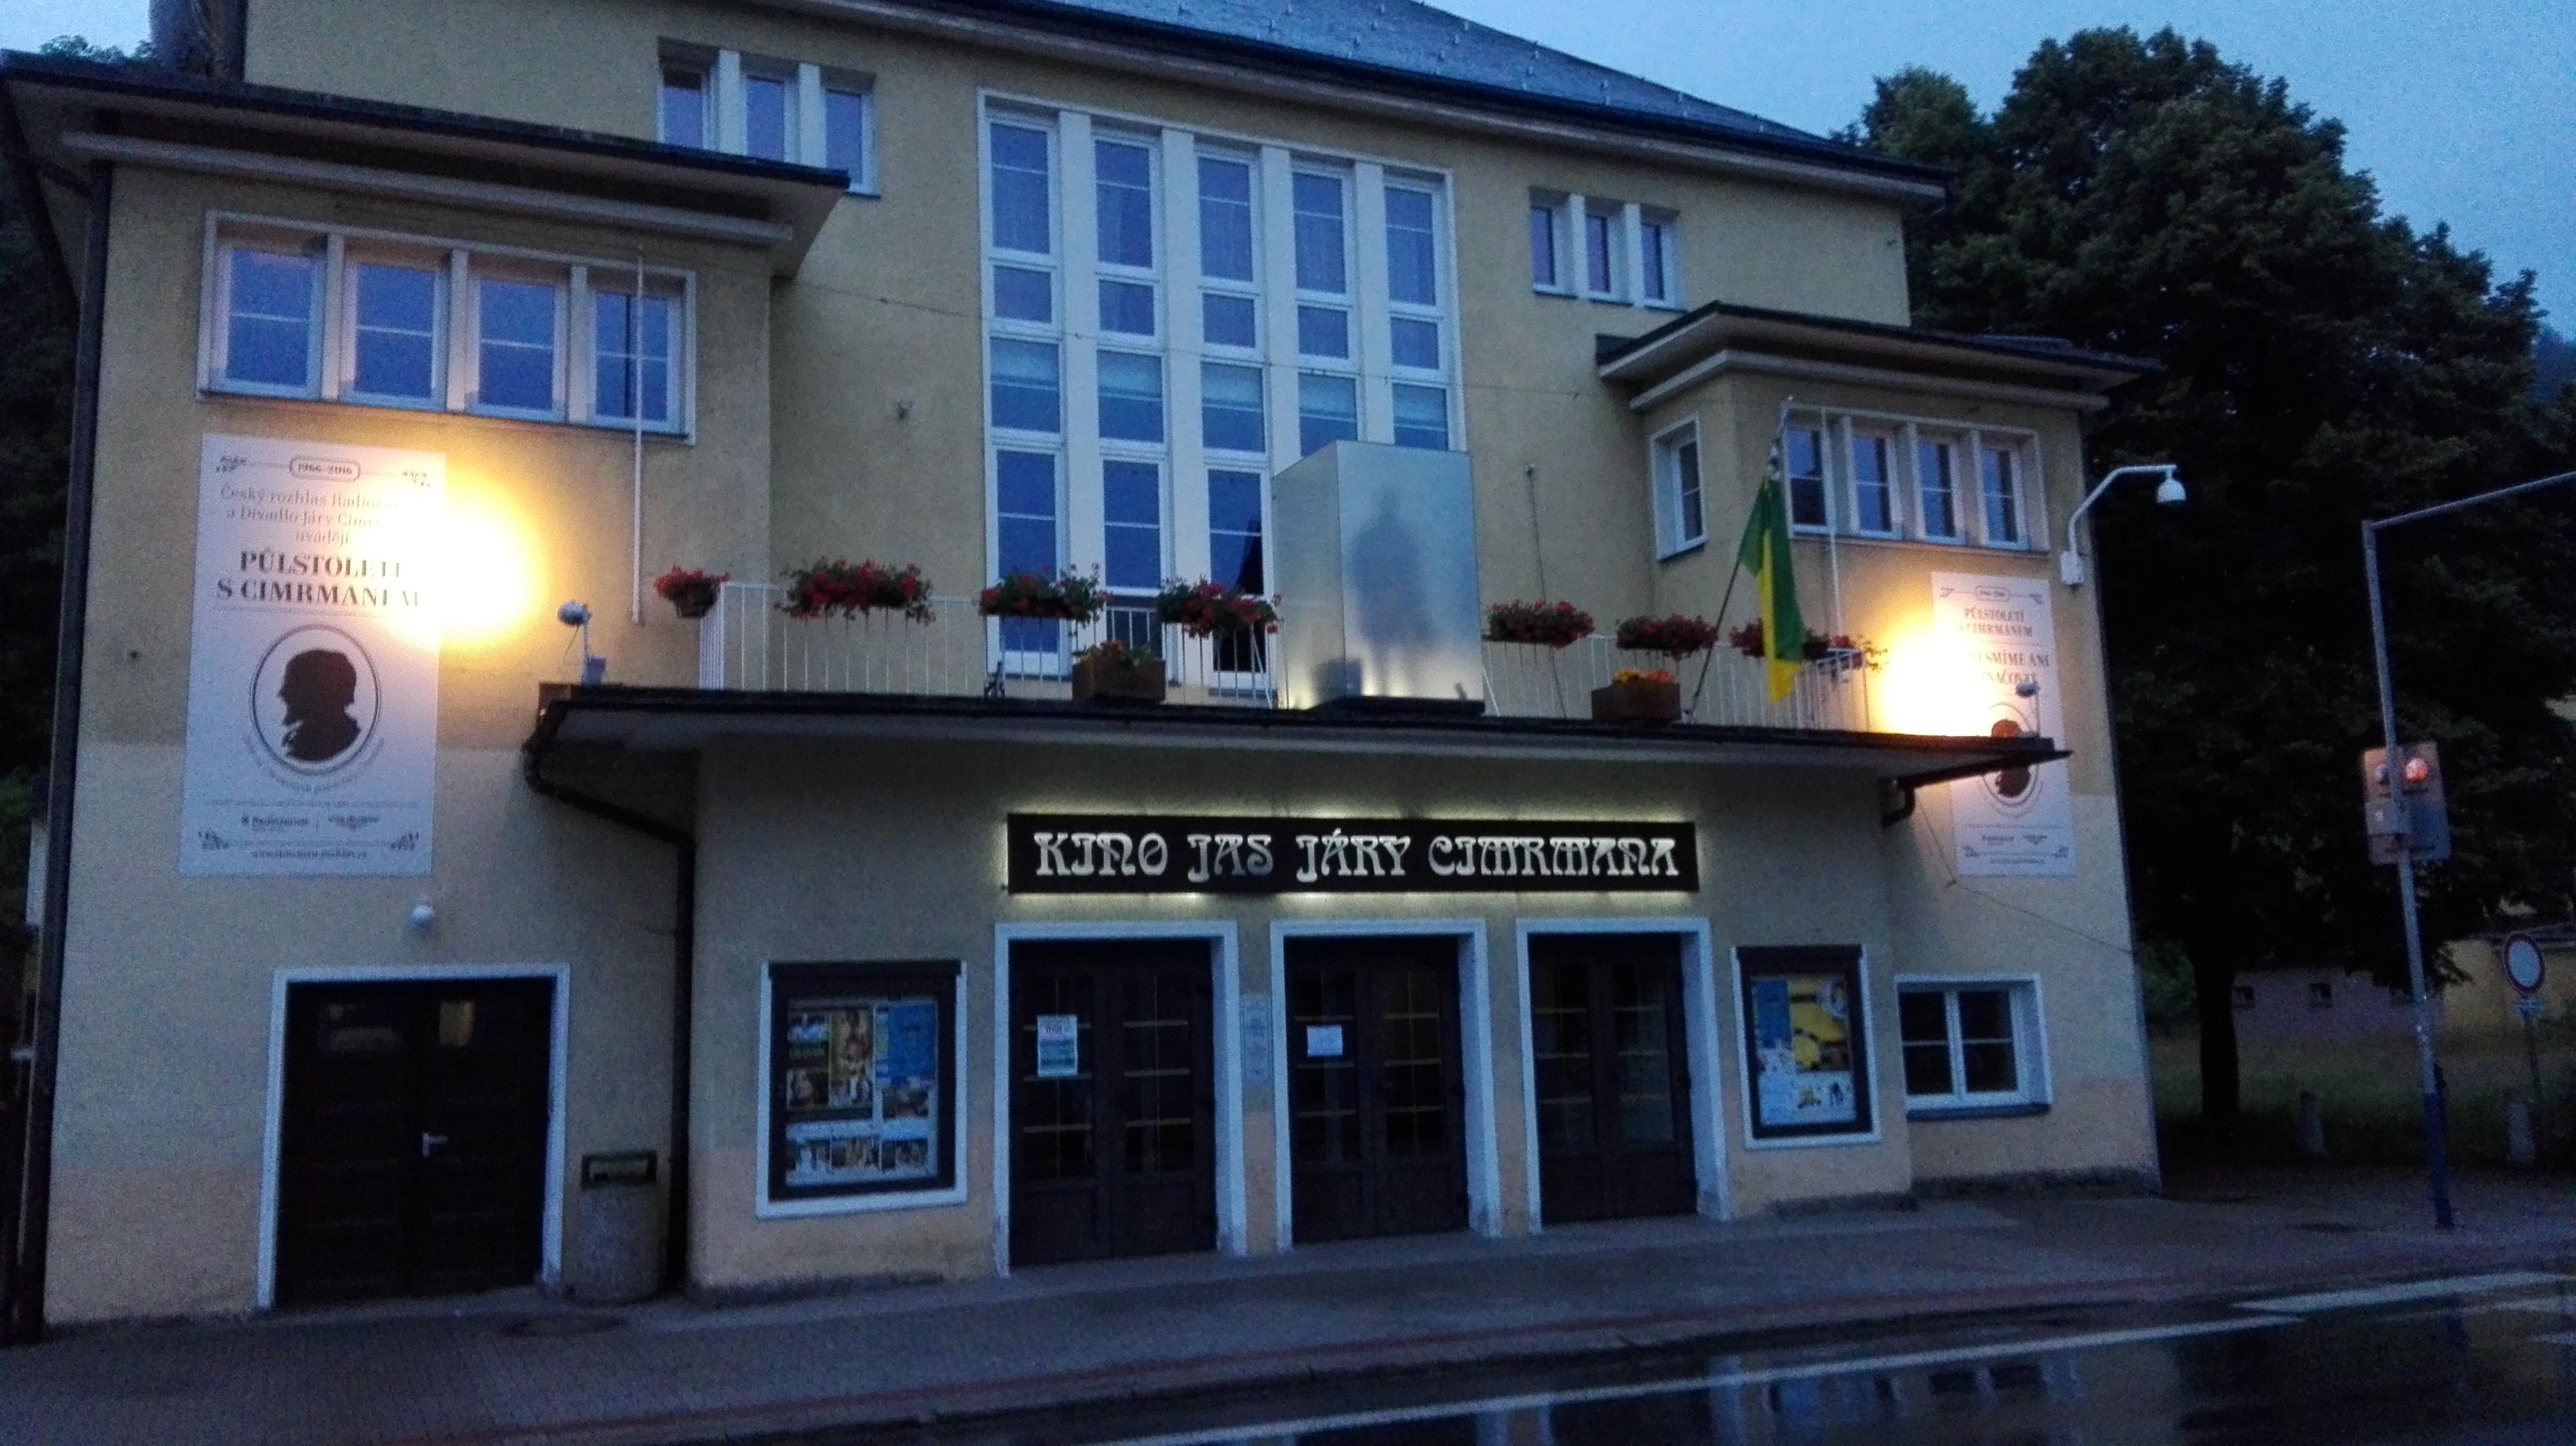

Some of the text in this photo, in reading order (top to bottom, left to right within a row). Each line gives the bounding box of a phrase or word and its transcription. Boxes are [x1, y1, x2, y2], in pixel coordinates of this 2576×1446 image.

[215, 578, 233, 601] S
[1034, 828, 1680, 883] KINO JAS JÁRY CIMRMANA
